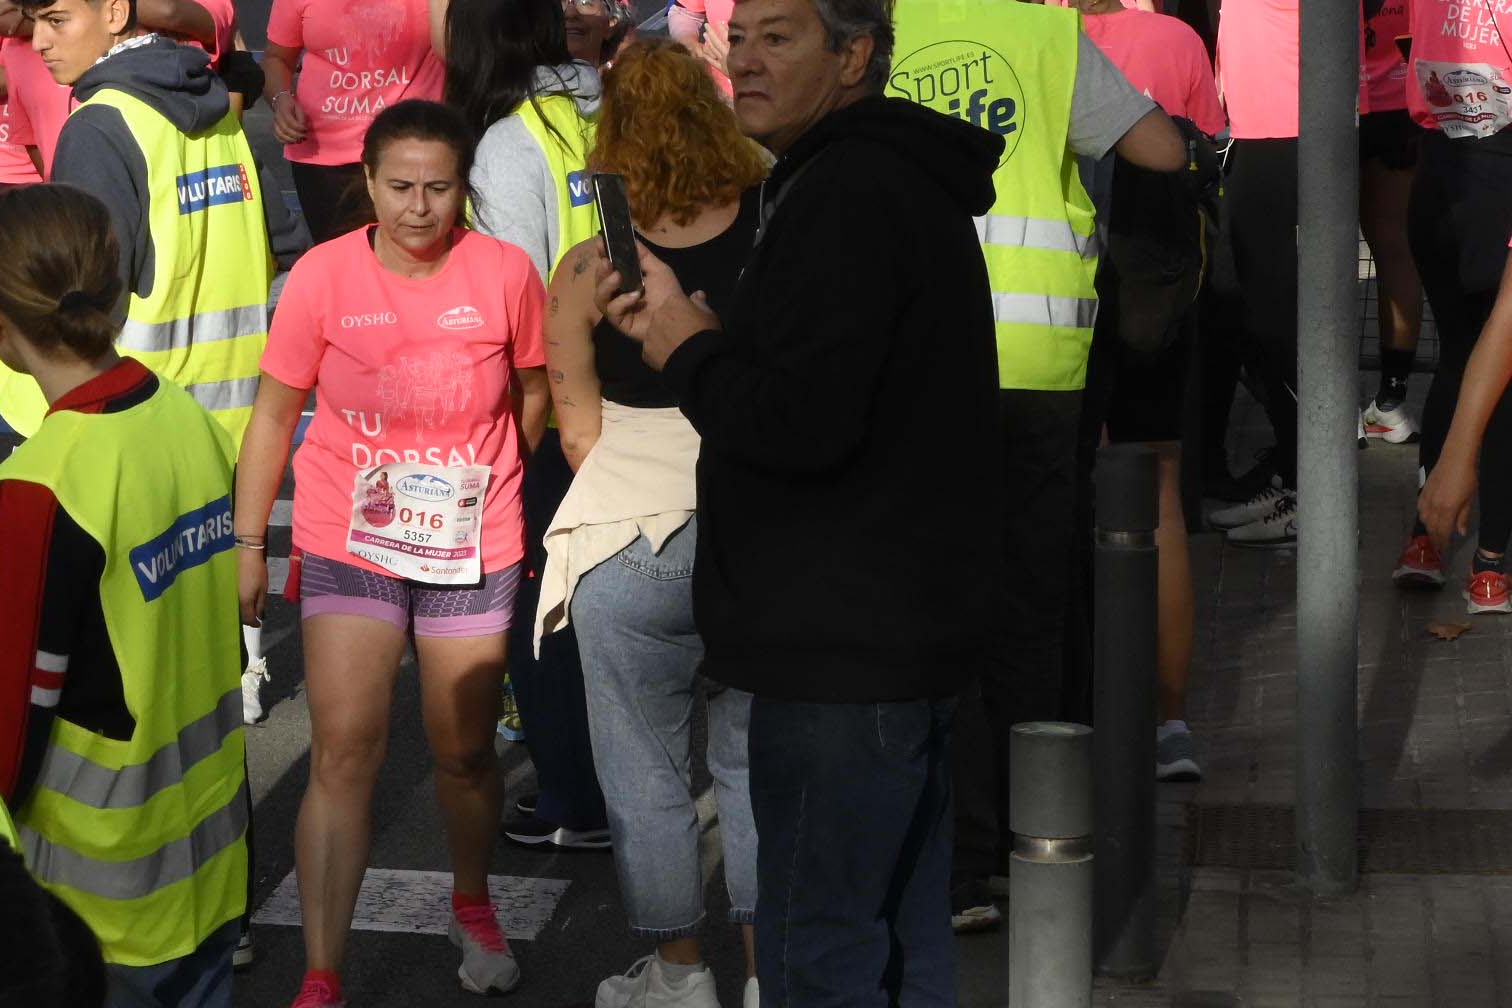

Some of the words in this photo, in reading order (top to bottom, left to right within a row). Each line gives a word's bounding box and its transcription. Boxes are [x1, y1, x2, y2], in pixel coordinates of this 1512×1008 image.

[1447, 3, 1471, 22] DE
[1476, 10, 1497, 26] LA
[1441, 21, 1501, 47] MUJER
[325, 47, 350, 66] TU
[330, 66, 411, 90] DORSAL
[889, 51, 994, 104] Sport
[321, 96, 387, 114] SUMA
[1454, 91, 1488, 104] 016
[341, 311, 398, 329] OYSHO
[342, 408, 382, 437] TU
[399, 507, 444, 529] 016
[364, 535, 400, 549] CARRERA
[401, 544, 412, 552] DE
[413, 547, 424, 555] LA
[424, 548, 451, 558] MUJER
[403, 529, 432, 543] 5357
